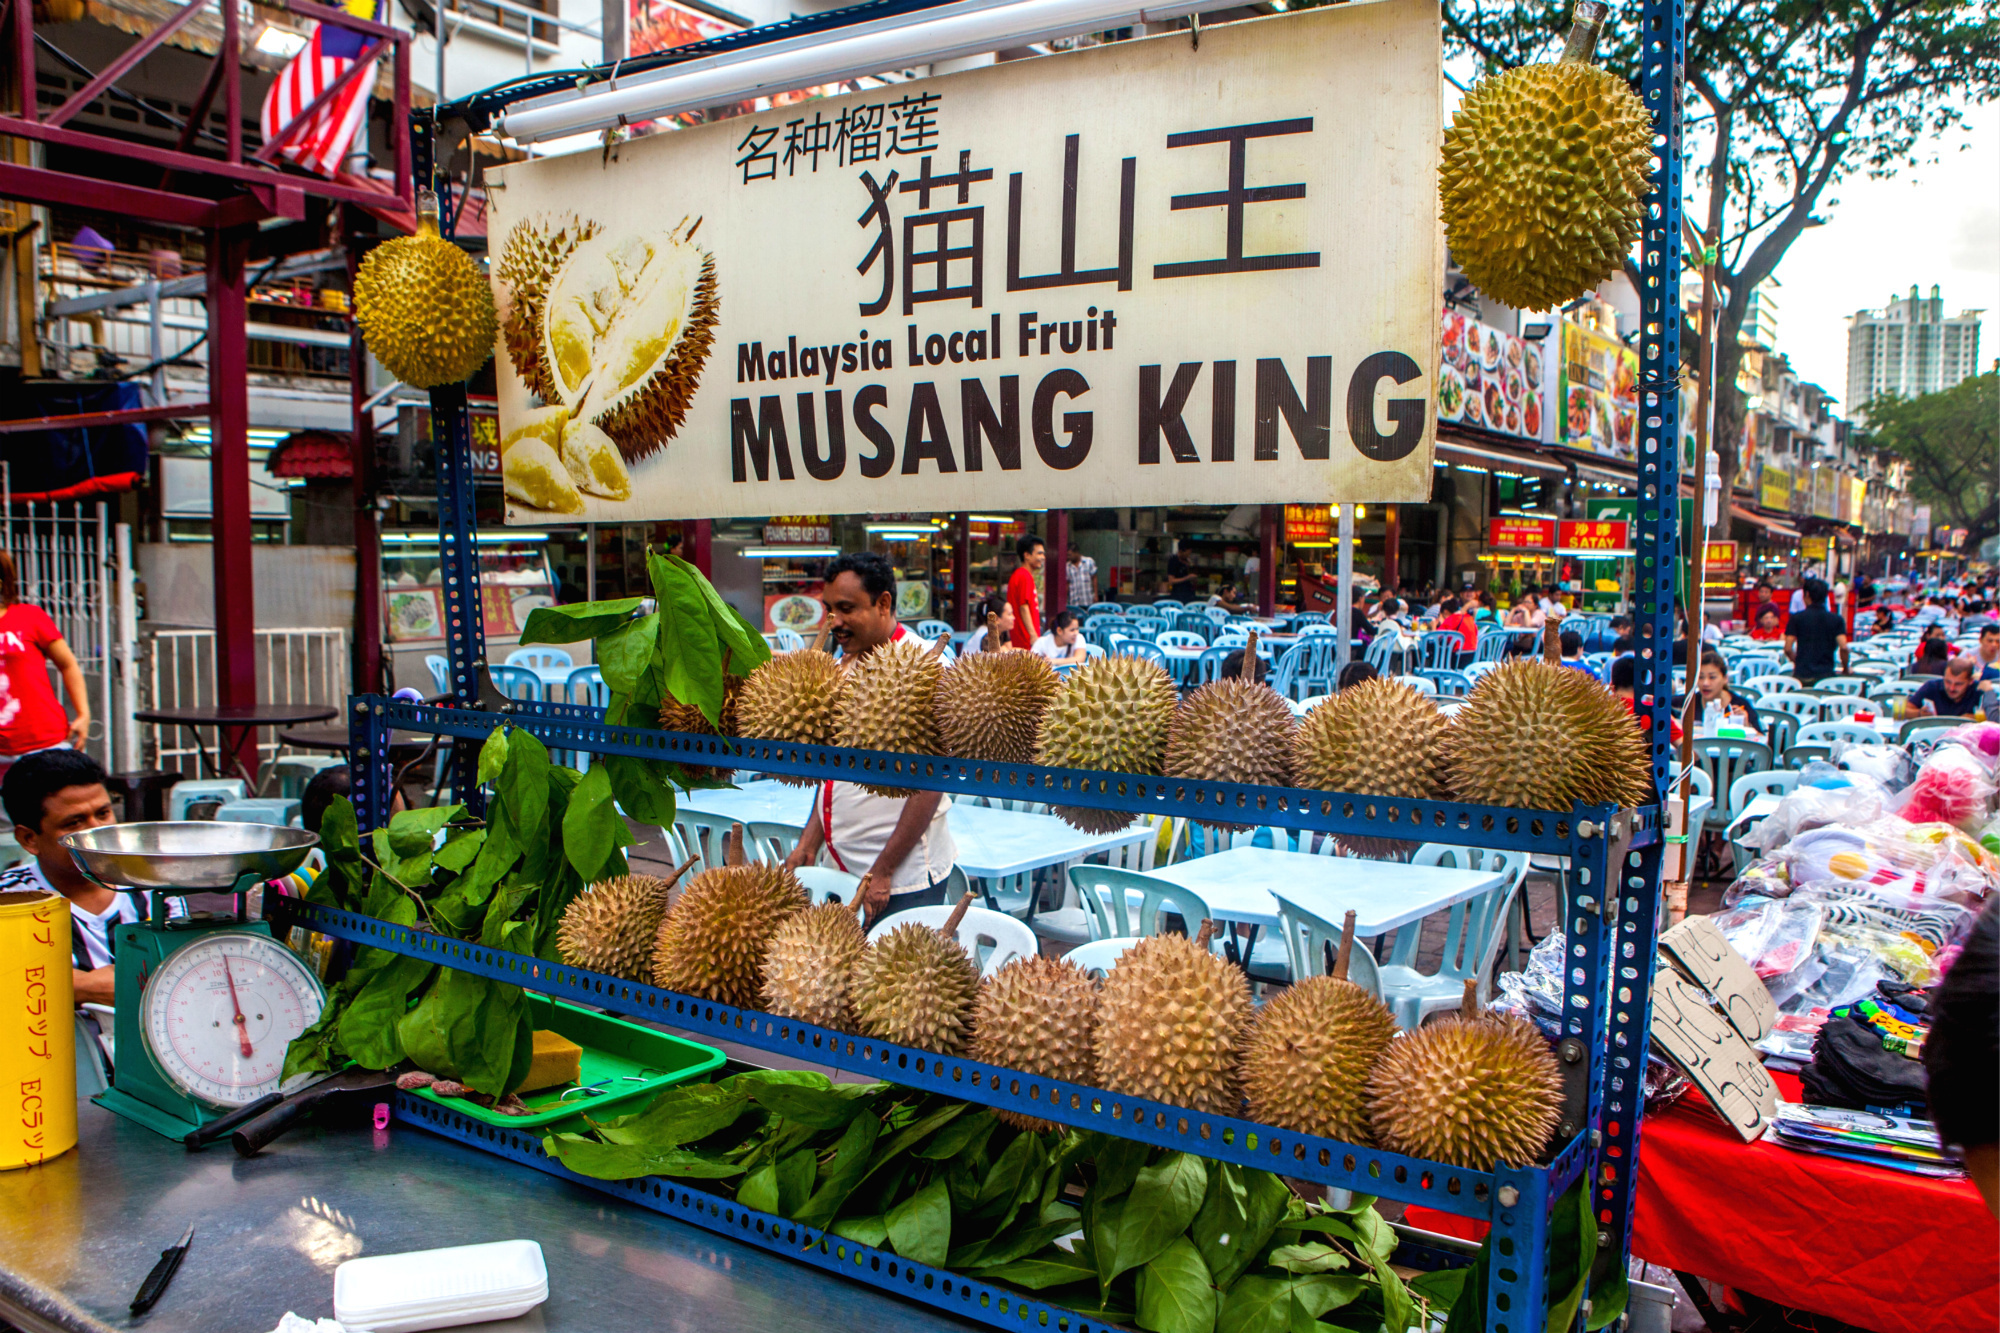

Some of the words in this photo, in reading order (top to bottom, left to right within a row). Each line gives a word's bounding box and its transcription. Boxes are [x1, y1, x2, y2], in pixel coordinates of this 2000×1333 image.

[735, 91, 943, 186] 名种榴莲
[857, 116, 1321, 317] 猫山王
[737, 329, 893, 386] Malaysia
[908, 313, 1001, 366] Local
[1018, 306, 1117, 357] Fruit
[730, 368, 1094, 483] MUSANG
[1138, 350, 1427, 465] KING
[470, 450, 499, 472] NG
[1569, 537, 1616, 548] SATAY
[212, 969, 222, 977] 10
[1711, 976, 1770, 1042] 5.00
[25, 964, 52, 1060] ECラップ
[1700, 1057, 1770, 1128] 5.00
